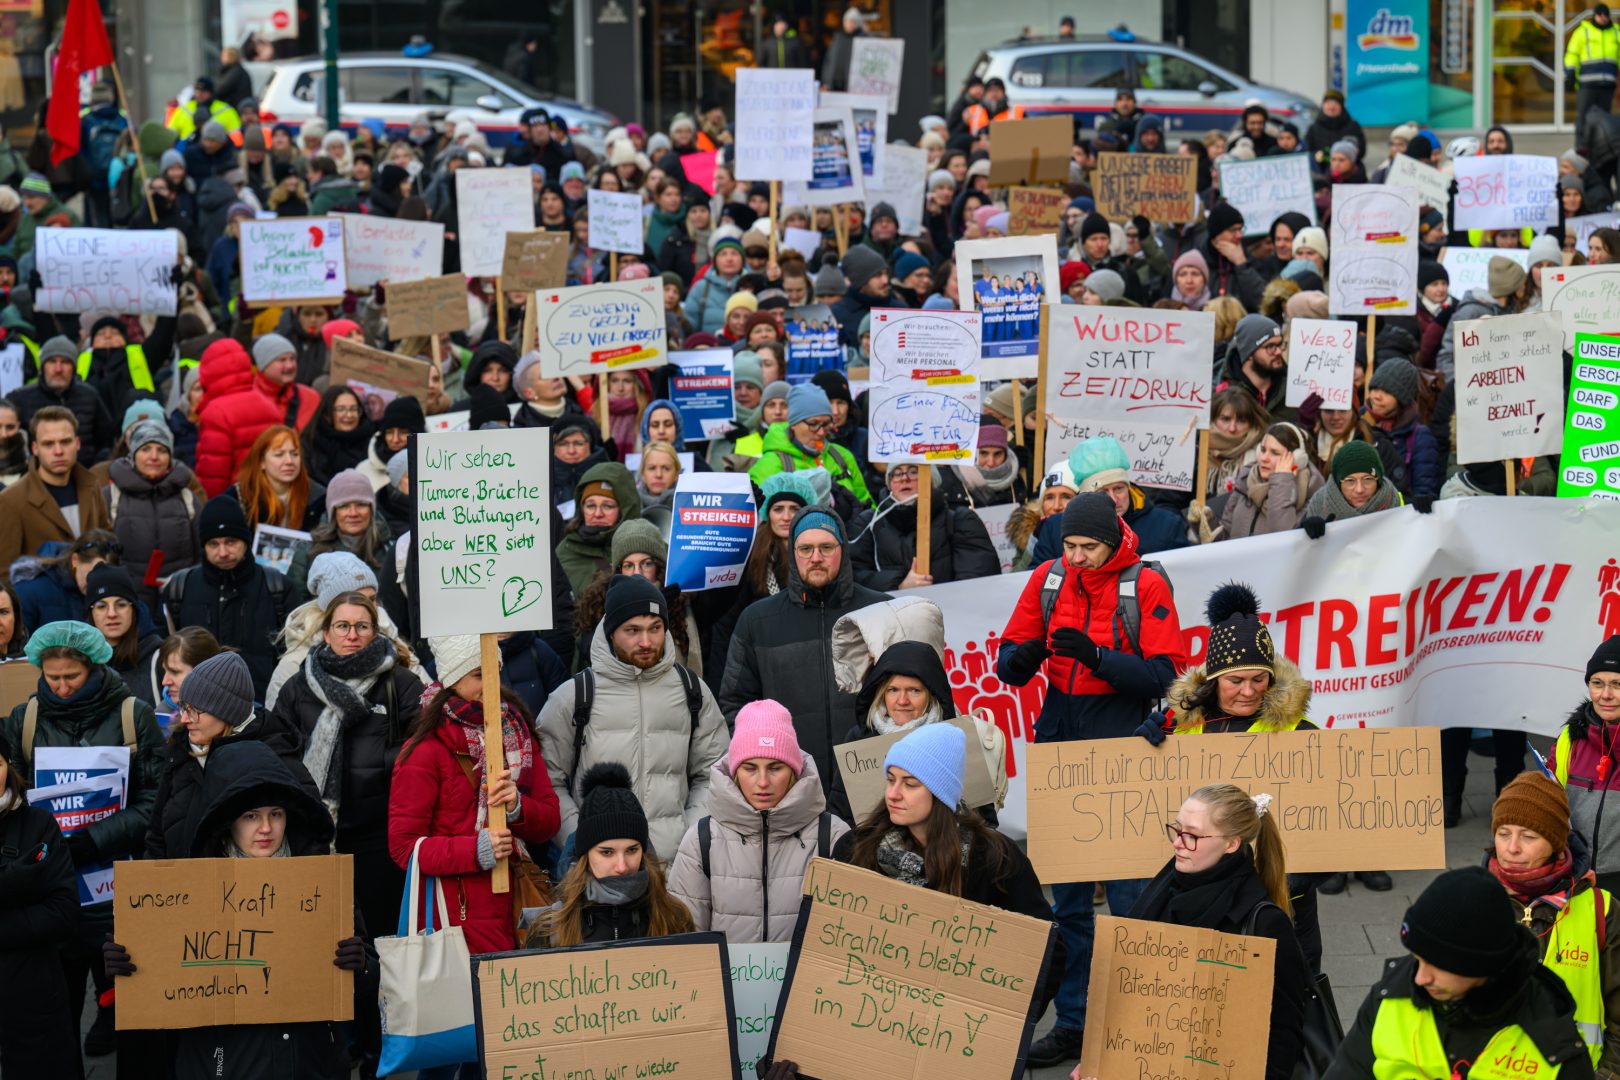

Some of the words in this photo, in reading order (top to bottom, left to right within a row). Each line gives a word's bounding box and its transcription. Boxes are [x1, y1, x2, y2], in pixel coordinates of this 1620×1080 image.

[1370, 12, 1410, 35] dm
[43, 231, 109, 256] KEINE
[45, 257, 122, 287] PFLEGE
[1566, 287, 1595, 302] Ohne
[984, 315, 1005, 323] mehr
[1005, 312, 1038, 322] können?
[555, 332, 582, 346] ZU
[587, 330, 621, 346] VIEL
[622, 327, 665, 342] ARBEIT
[1073, 313, 1186, 345] WÜRDE
[1300, 328, 1338, 347] WER
[1462, 331, 1480, 348] Ich
[1489, 330, 1511, 343] kann
[1522, 329, 1537, 342] gar
[919, 358, 957, 366] PERSONAL
[1086, 350, 1156, 369] STATT
[1471, 352, 1492, 365] nicht
[1500, 352, 1510, 360] so
[1520, 345, 1552, 358] schlecht
[681, 366, 706, 376] WIR
[1467, 365, 1526, 388] ARBEITEN
[677, 378, 729, 388] STREIKEN!
[1059, 371, 1211, 404] ZEITDRUCK
[896, 394, 936, 409] Einer
[1466, 397, 1479, 407] wie
[1576, 390, 1612, 407] DARF
[947, 407, 980, 423] ALLE
[1488, 400, 1537, 421] BEZAHLT
[881, 422, 923, 439] ALLE
[929, 424, 962, 440] FÜR
[1502, 426, 1529, 438] werde
[1575, 414, 1603, 429] DAS
[425, 445, 457, 471] Wir
[461, 445, 516, 469] sehen
[1134, 457, 1165, 472] nicht
[1566, 470, 1594, 484] DES
[419, 479, 475, 503] Tumore,
[476, 479, 540, 501] Brüche
[692, 494, 722, 507] WIR
[420, 506, 446, 522] und
[452, 505, 540, 532] Blutungen,
[683, 511, 751, 524] STREIKEN!
[421, 532, 455, 551] aber
[465, 534, 498, 553] WER
[676, 534, 747, 543] GESUNDHEITSVERSORGUNG
[680, 545, 740, 553] ARBEITSBEDINGUNGEN
[709, 570, 737, 584] vida
[1336, 706, 1395, 721] GEWERKSCHAFT
[845, 750, 880, 774] Ohne
[1105, 753, 1132, 785] wir
[1139, 739, 1190, 781] auch
[1200, 749, 1222, 780] in
[1231, 733, 1325, 784] Zukunft
[1336, 733, 1364, 783] für
[1370, 729, 1431, 777] Euch
[50, 795, 85, 811] WIR
[1270, 781, 1328, 832] Team
[1336, 778, 1443, 835] Radiologie
[129, 892, 190, 909] unsere
[221, 880, 276, 918] Kraft
[299, 886, 322, 913] ist
[809, 866, 868, 912] Wenn
[880, 903, 919, 926] wir
[931, 914, 998, 947] nicht
[183, 929, 274, 961] NICHT
[818, 916, 910, 969] strahlen,
[918, 940, 976, 978] bleibt
[980, 966, 1025, 992] eure
[1114, 925, 1189, 972] Radiologie
[1555, 942, 1589, 962] vida
[164, 973, 248, 1001] unendlich
[627, 964, 678, 991] sein,
[837, 953, 946, 1014] Diagnose
[1116, 967, 1231, 1003] Patientensicherheit
[502, 1013, 541, 1043] das
[552, 1001, 641, 1035] schaffen
[814, 987, 843, 1019] im
[851, 992, 953, 1053] Dunkeln
[1145, 1006, 1160, 1028] in
[1105, 1027, 1131, 1051] Wir
[1134, 1032, 1175, 1056] wollen
[1189, 1037, 1219, 1067] faire
[605, 1062, 628, 1079] wir
[635, 1057, 680, 1079] wieder
[1494, 1045, 1539, 1075] vida
